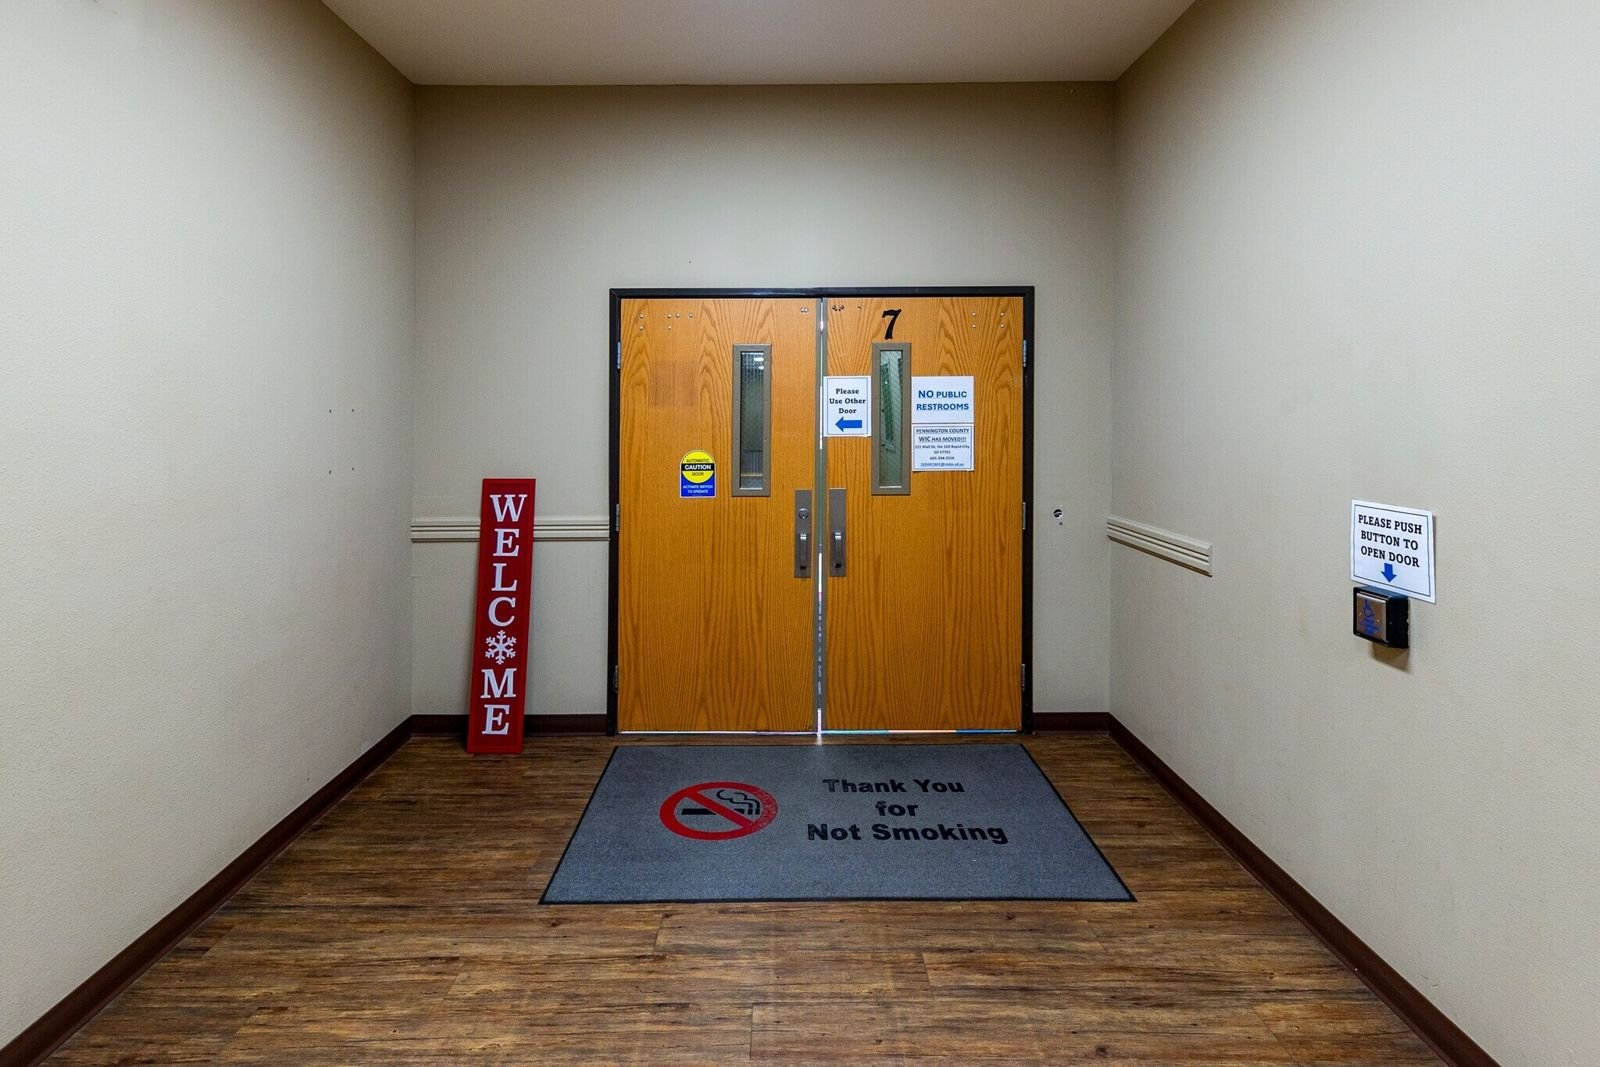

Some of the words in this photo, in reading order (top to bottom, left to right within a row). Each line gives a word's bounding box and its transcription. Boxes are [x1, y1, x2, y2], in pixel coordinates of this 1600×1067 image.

[882, 309, 902, 340] 7
[918, 390, 934, 398] NO
[916, 403, 969, 411] RESTROOMS
[1358, 514, 1392, 530] PLEASE
[1394, 520, 1422, 535] PUSH
[1360, 530, 1400, 547] BUTTON
[1402, 538, 1418, 550] TO
[1360, 546, 1386, 560] OPEN
[1388, 551, 1420, 568] DOOR
[480, 493, 528, 736] WELCME
[822, 778, 907, 793] Thank
[913, 779, 965, 793] You
[875, 800, 918, 817] for
[807, 824, 862, 841] Not
[871, 824, 1009, 845] Smoking
